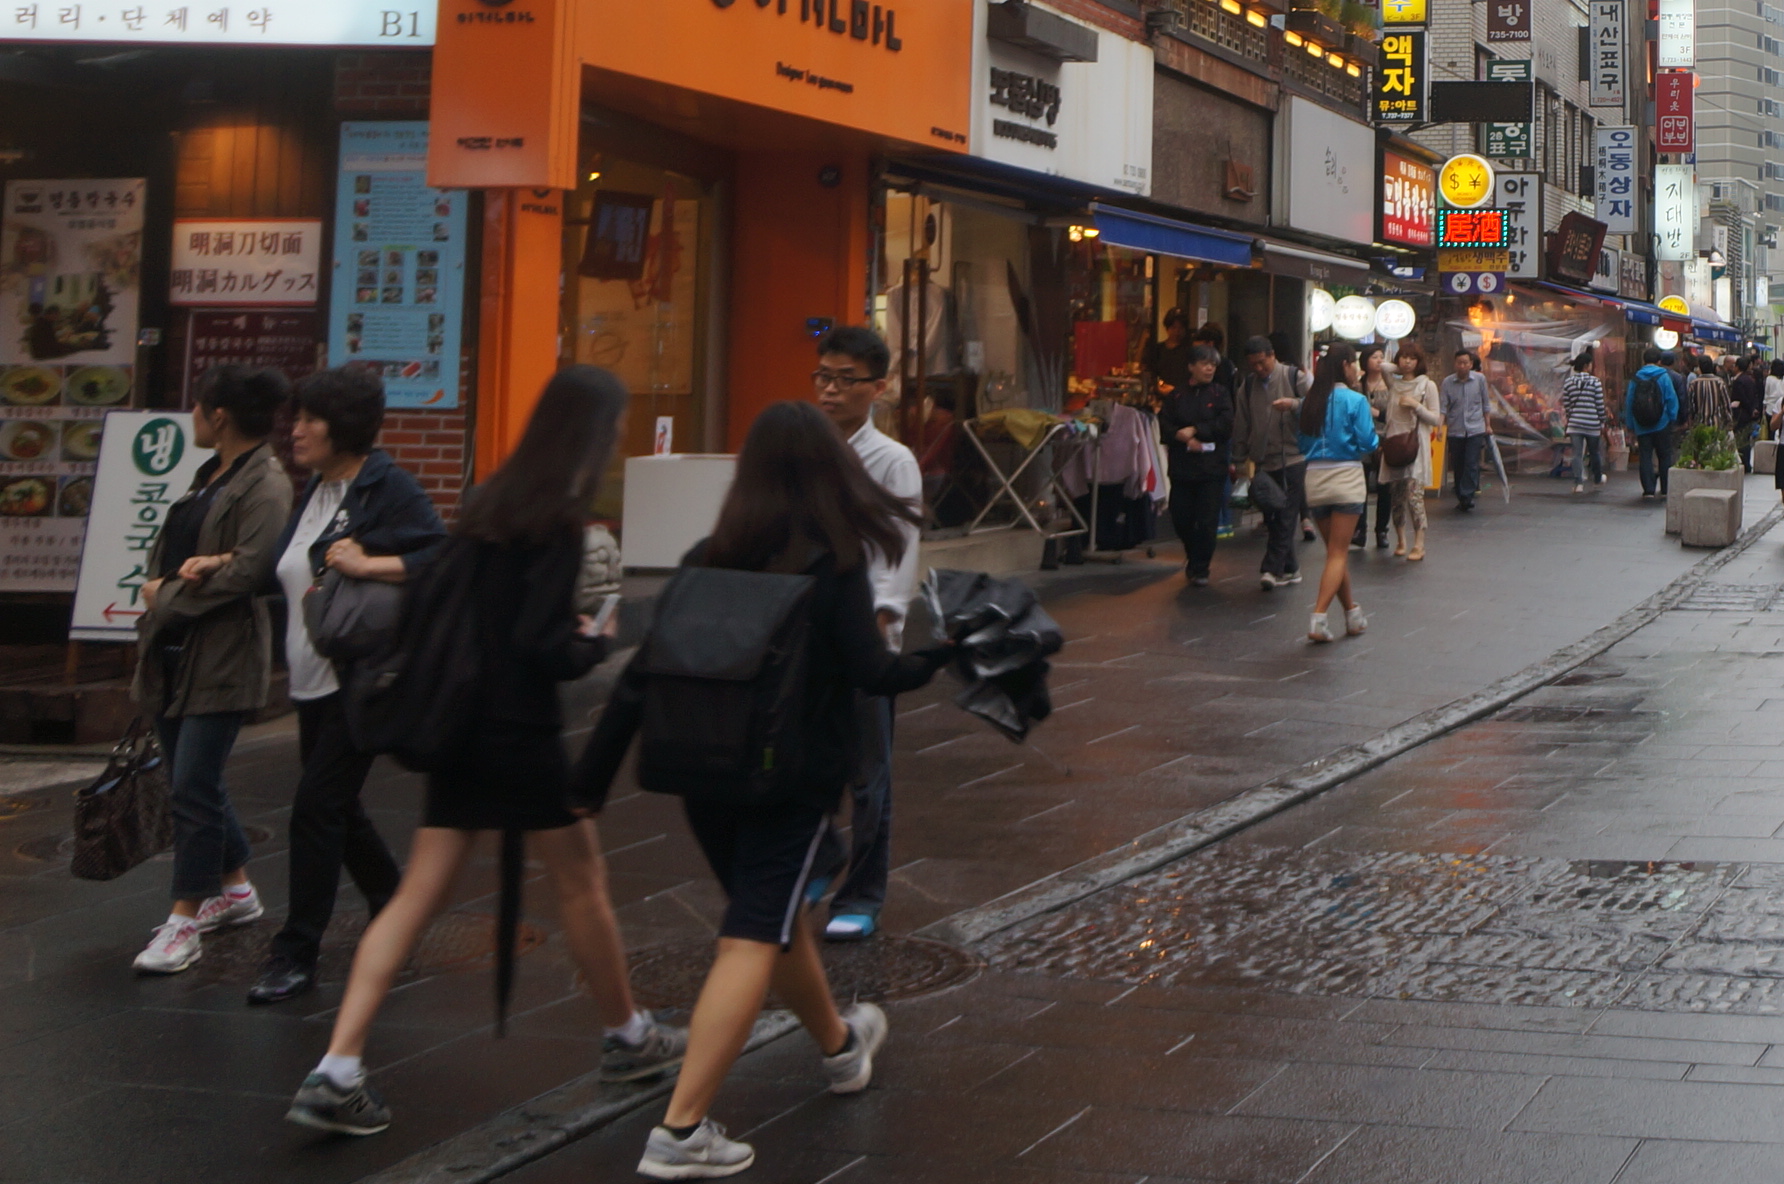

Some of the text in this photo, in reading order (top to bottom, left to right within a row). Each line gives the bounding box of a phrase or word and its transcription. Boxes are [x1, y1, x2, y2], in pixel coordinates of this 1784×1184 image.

[379, 10, 423, 39] B1
[1488, 30, 1529, 40] 735-7100
[1680, 45, 1691, 54] 3F
[1381, 35, 1416, 97] 액자
[1379, 99, 1418, 112] 뮤:아트
[1489, 141, 1527, 155] 표구
[1607, 130, 1633, 218] 오동상자
[1664, 179, 1684, 248] 지대방
[189, 231, 304, 256] 明洞刀切面
[140, 423, 180, 476] 냉
